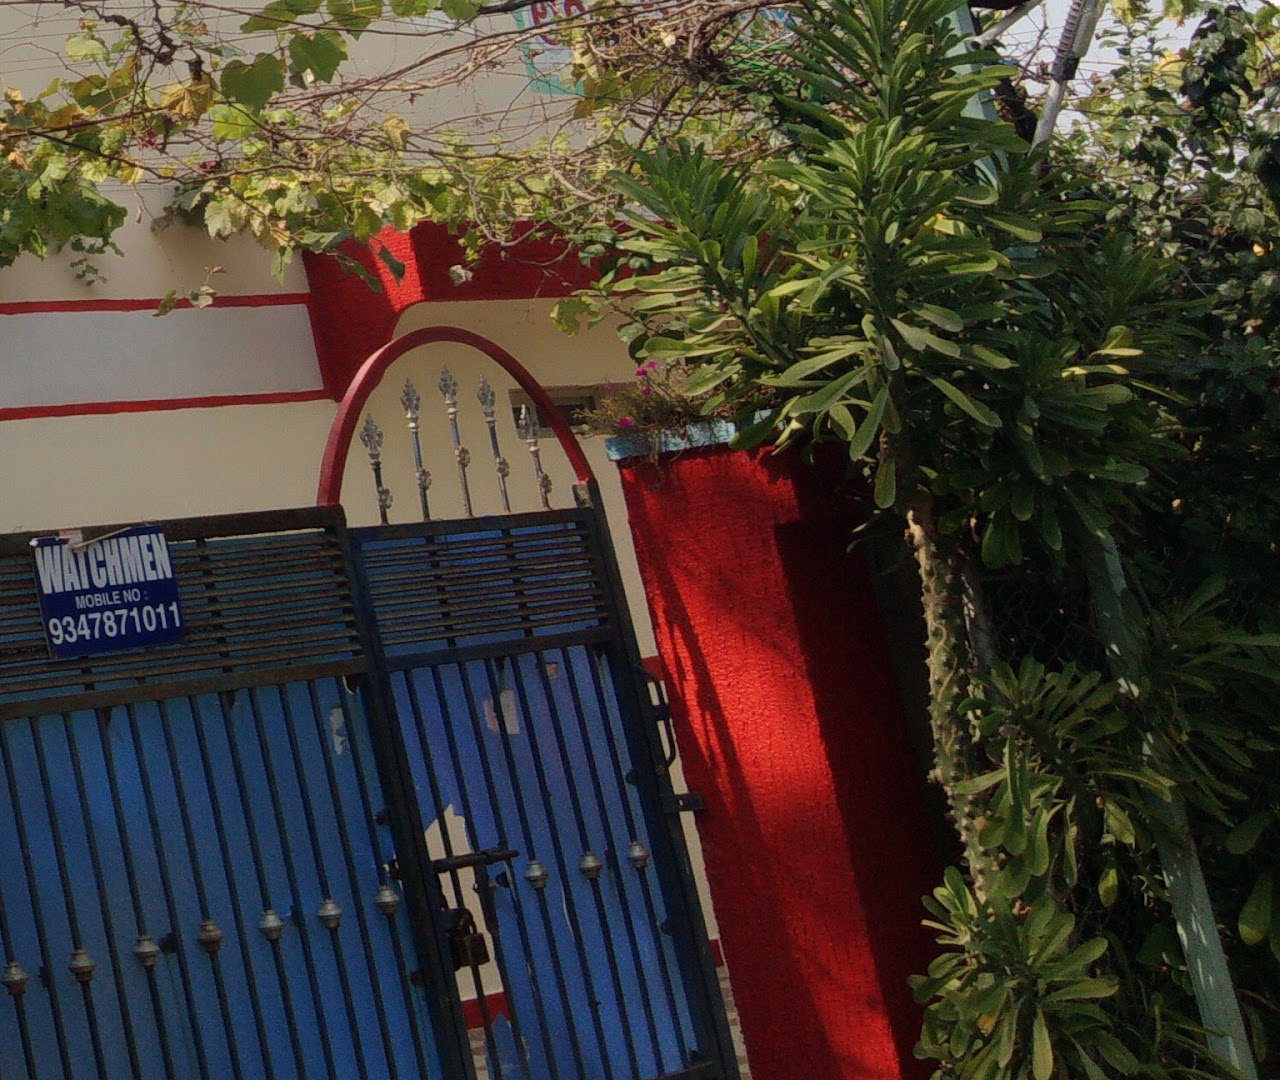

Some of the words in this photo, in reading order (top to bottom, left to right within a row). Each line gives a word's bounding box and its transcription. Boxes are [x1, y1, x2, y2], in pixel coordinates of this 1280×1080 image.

[34, 533, 174, 595] WATCHMEN
[74, 591, 122, 610] MOBILE
[49, 601, 181, 645] 9347871011
